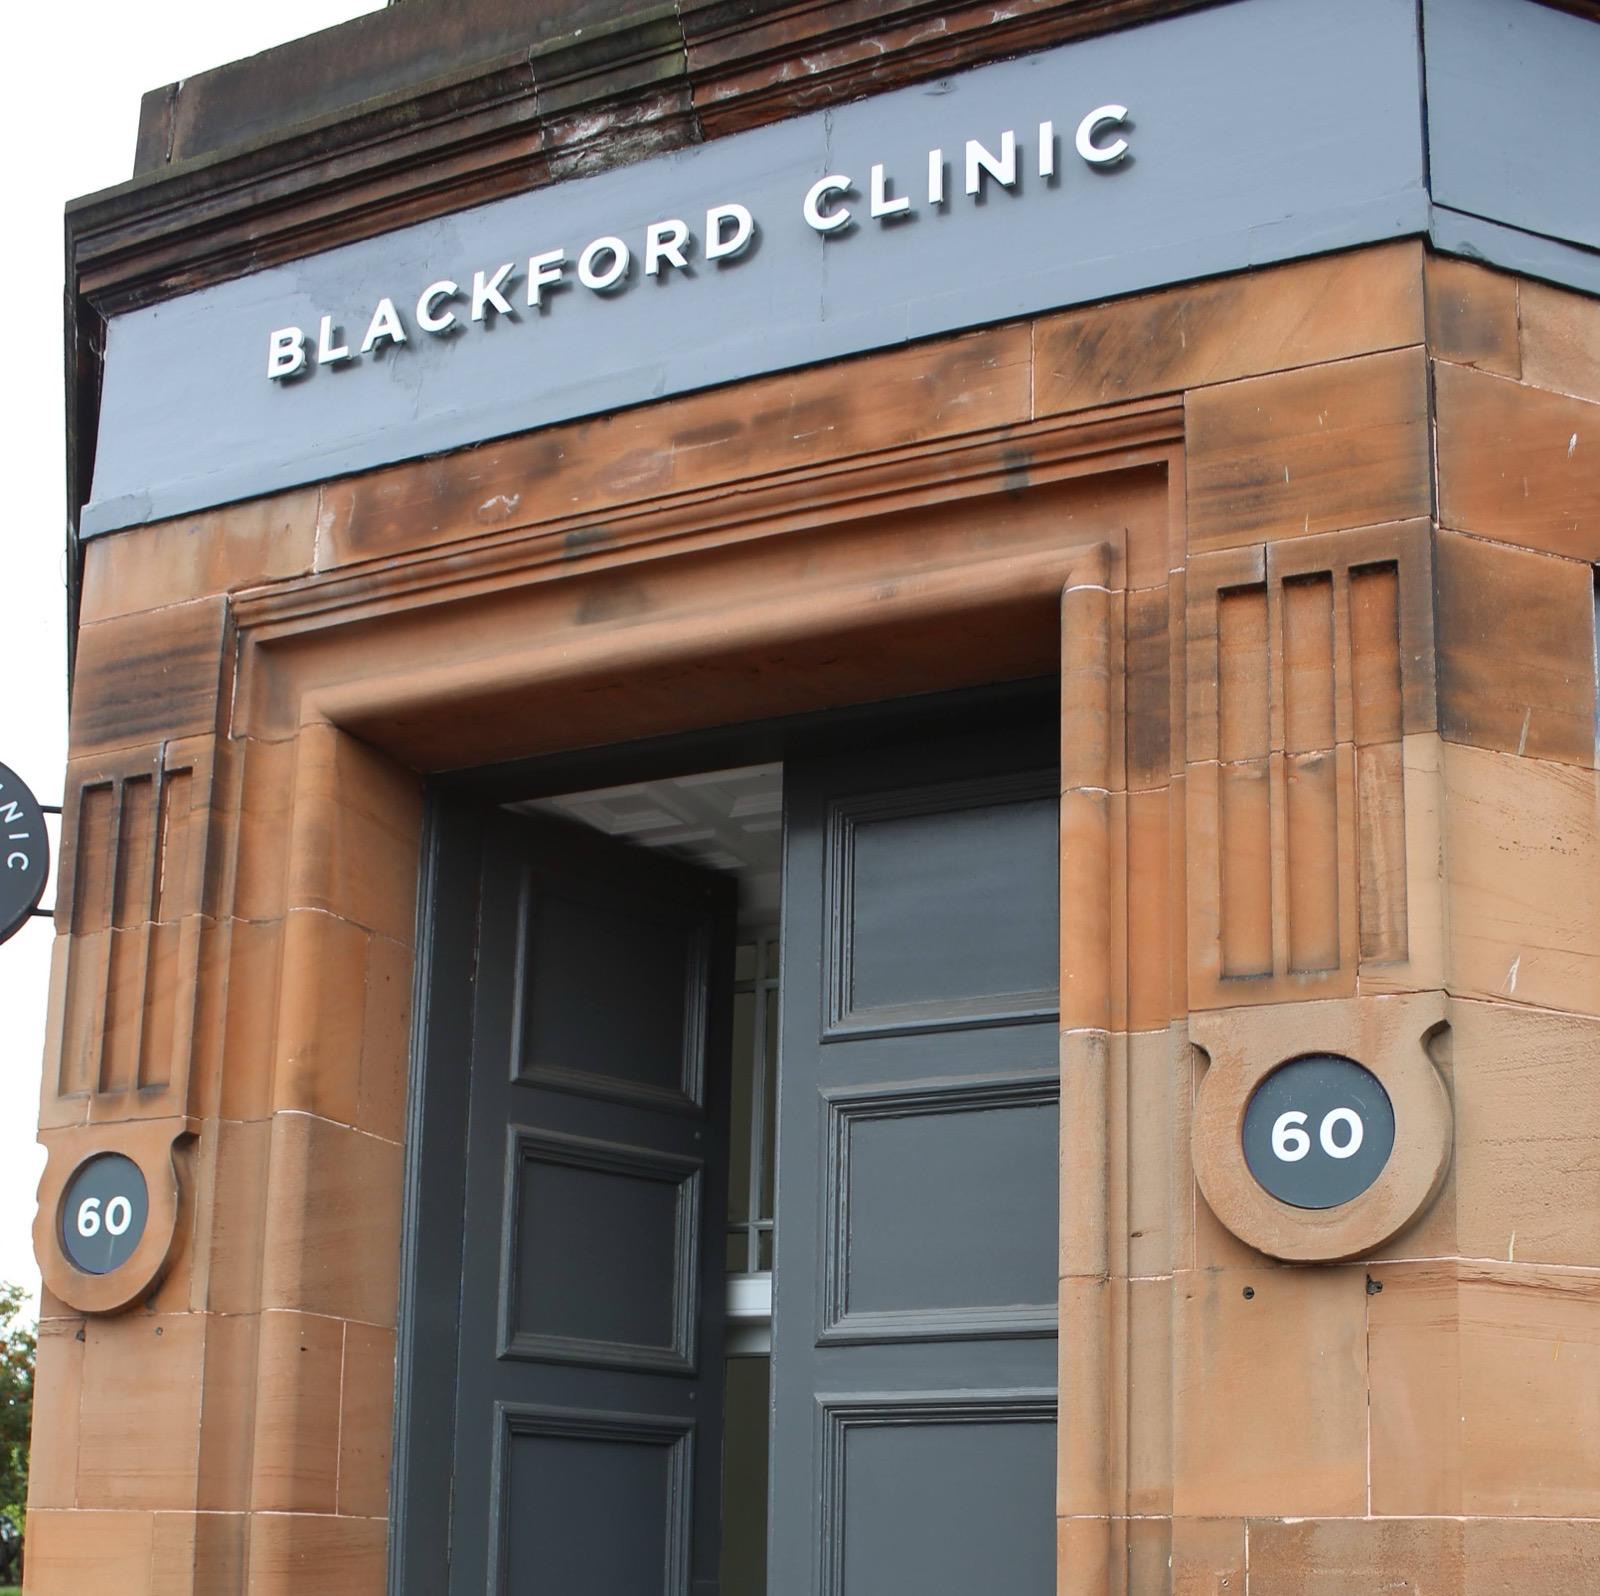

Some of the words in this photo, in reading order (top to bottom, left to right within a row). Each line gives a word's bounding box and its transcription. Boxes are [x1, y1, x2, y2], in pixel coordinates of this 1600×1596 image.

[267, 204, 754, 380] BLACKFORD
[803, 104, 1130, 232] CLINIC
[0, 784, 30, 871] NIC
[1271, 1107, 1364, 1162] 60
[77, 1196, 132, 1237] 60
